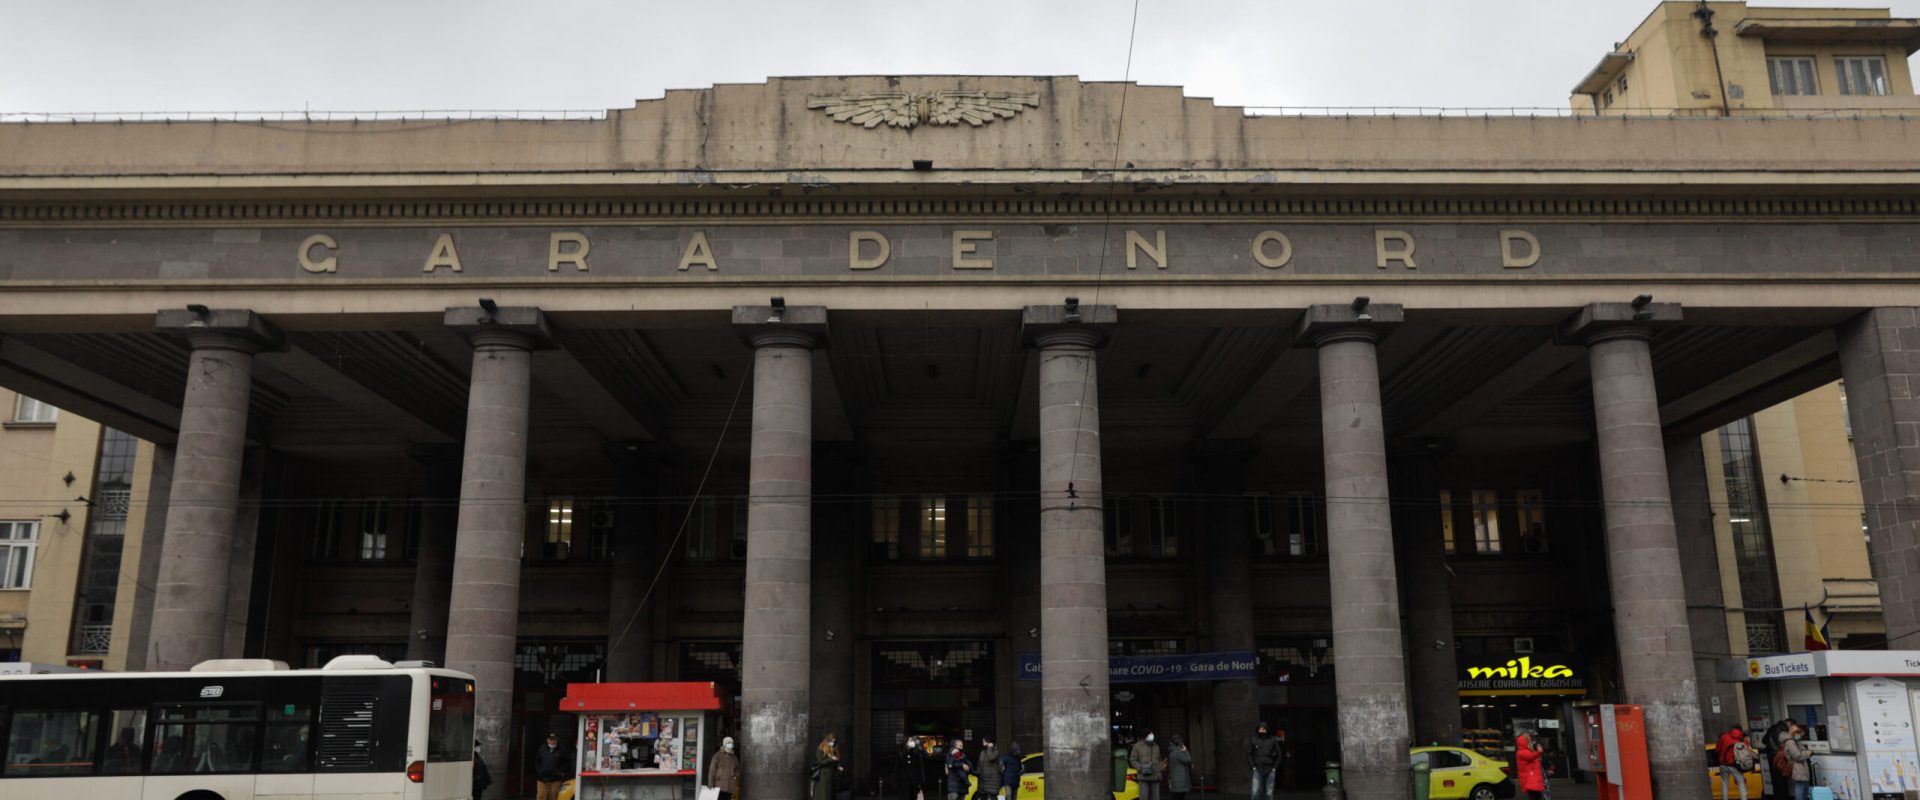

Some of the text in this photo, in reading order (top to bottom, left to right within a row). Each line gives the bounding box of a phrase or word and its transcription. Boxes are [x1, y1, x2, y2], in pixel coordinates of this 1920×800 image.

[298, 229, 1541, 273] GARA DE NORD
[1130, 664, 1165, 676] COVID
[1190, 663, 1215, 672] Gara
[1216, 661, 1230, 671] de
[1231, 660, 1255, 671] Nord
[1466, 655, 1574, 679] mika
